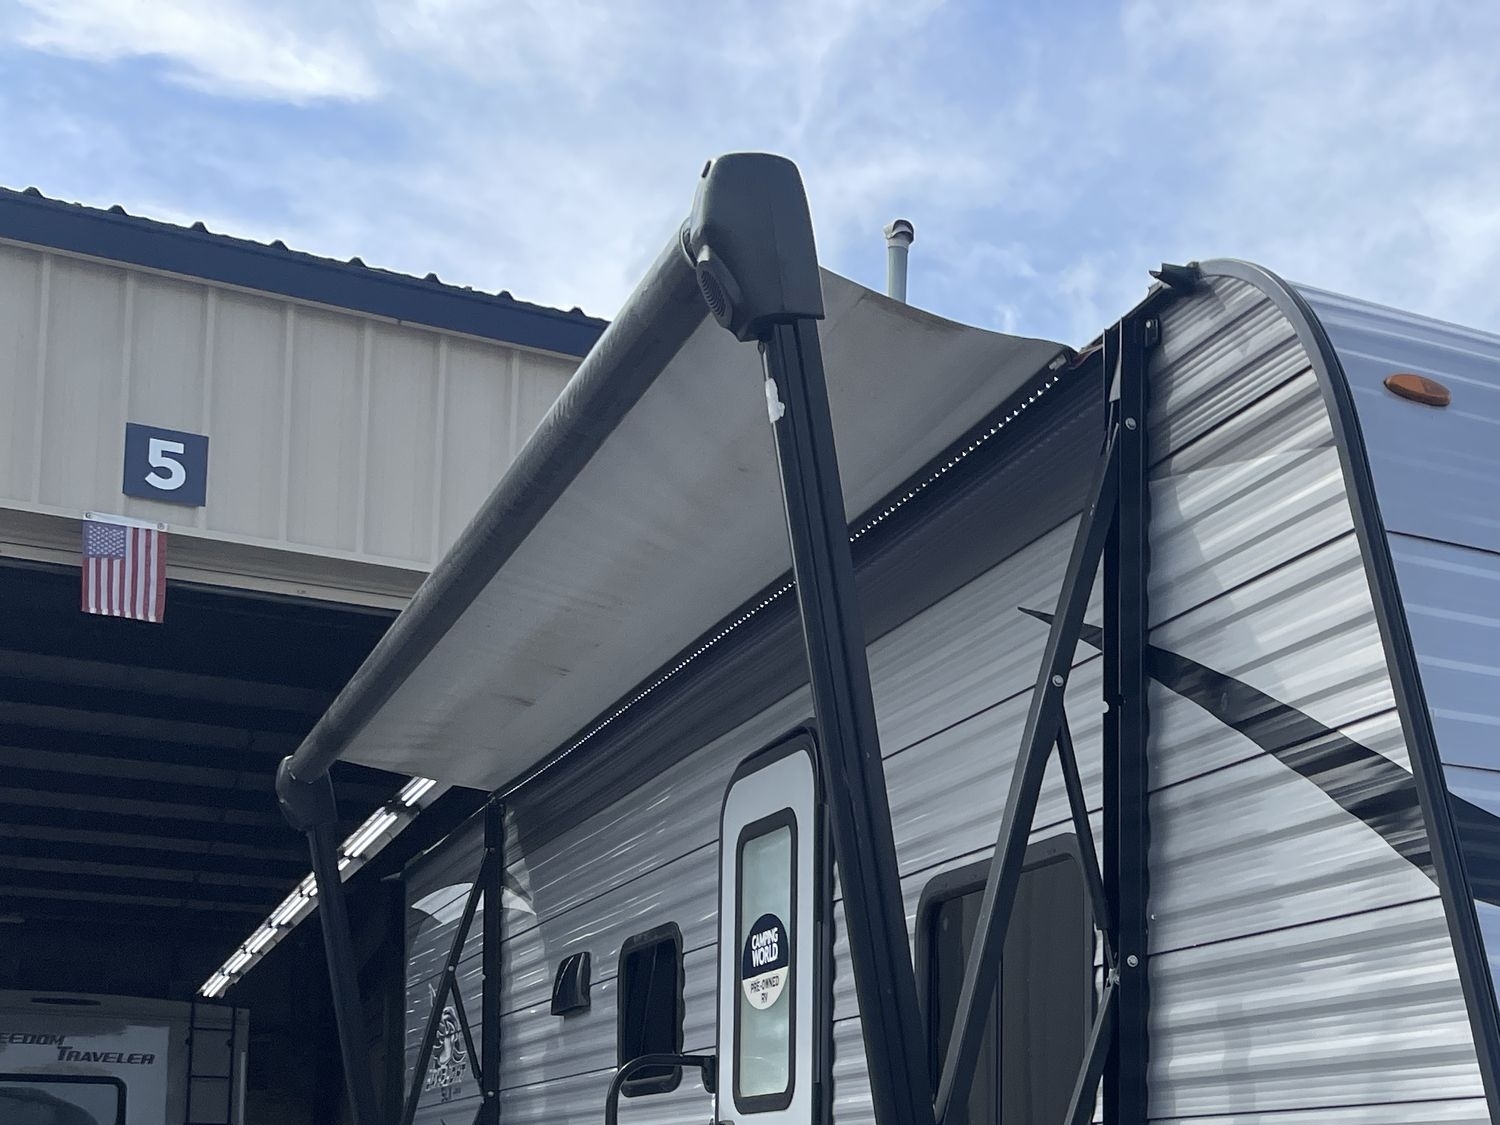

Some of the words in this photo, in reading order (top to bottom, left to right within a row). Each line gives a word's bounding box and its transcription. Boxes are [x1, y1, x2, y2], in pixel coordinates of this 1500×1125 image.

[145, 437, 187, 491] 5
[752, 927, 778, 950] CAMPING
[752, 943, 778, 967] WORLD
[751, 976, 779, 993] PRE-OWNED
